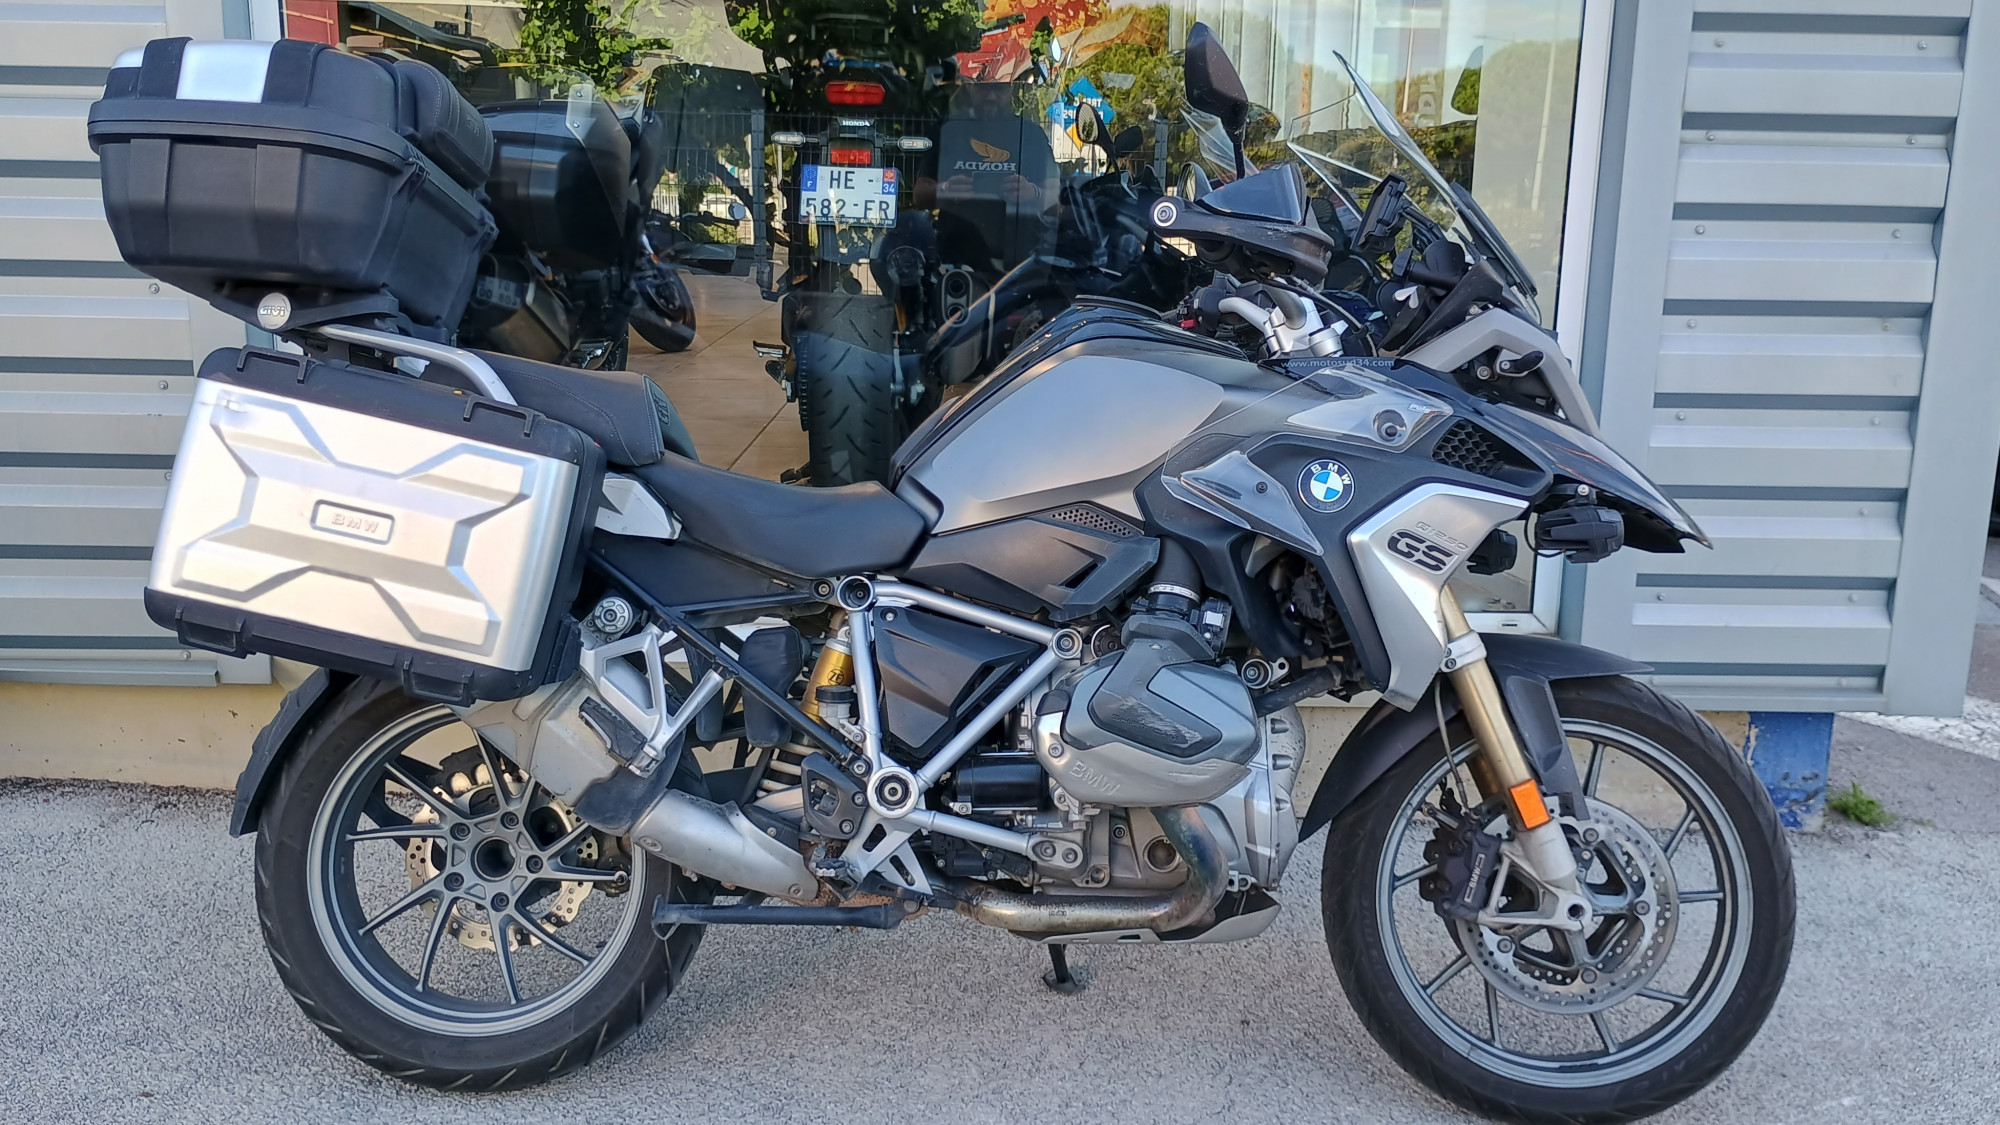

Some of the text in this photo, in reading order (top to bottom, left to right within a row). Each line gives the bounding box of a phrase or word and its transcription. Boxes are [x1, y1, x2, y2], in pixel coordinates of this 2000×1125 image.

[829, 170, 855, 190] HE
[882, 183, 895, 194] 34
[259, 304, 286, 317] GIVI
[1280, 358, 1395, 368] www.motosud34.com
[1310, 462, 1351, 485] BMW
[331, 512, 380, 533] BMW
[1387, 531, 1454, 572] GS
[829, 670, 845, 683] ZF
[1070, 761, 1120, 796] BMW
[1468, 865, 1481, 888] BMW
